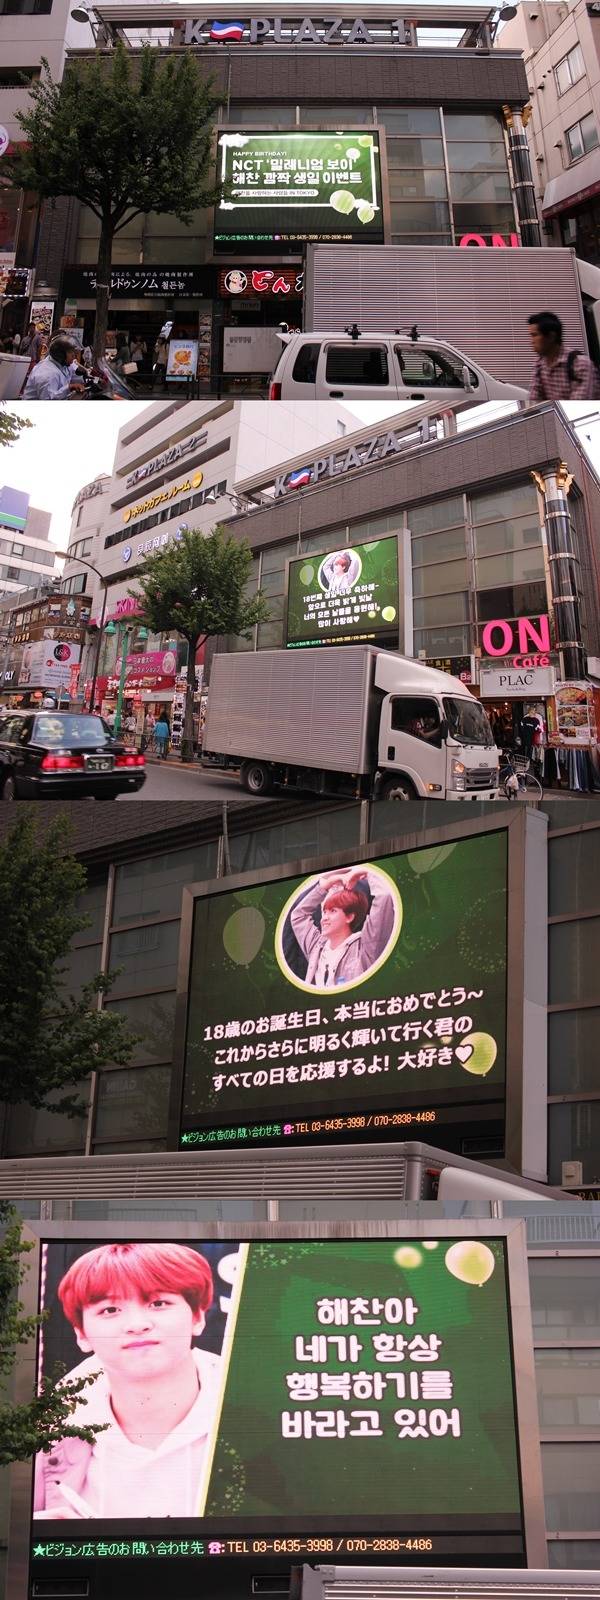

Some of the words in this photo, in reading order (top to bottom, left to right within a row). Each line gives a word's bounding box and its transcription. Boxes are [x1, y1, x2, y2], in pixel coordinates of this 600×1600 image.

[184, 19, 208, 44] K
[250, 18, 372, 44] PLAZA
[392, 18, 406, 44] 1
[232, 160, 263, 170] NCT
[327, 159, 357, 171] 보이'
[232, 172, 259, 184] 해찬
[263, 172, 291, 184] 깜짝
[294, 172, 319, 184] 생일
[322, 172, 362, 184] 이벤트
[274, 474, 288, 498] K
[311, 431, 401, 483] PLAZA
[482, 614, 550, 657] ON
[513, 652, 550, 669] Café
[499, 675, 533, 686] PLAC
[214, 1015, 473, 1066] これからさらに明るく輝いて行く君の
[397, 1047, 453, 1072] 大好き
[296, 1124, 310, 1134] TEL
[311, 1117, 366, 1132] 03-6435-3998
[374, 1111, 436, 1126] 070-2838-4486
[316, 1297, 418, 1327] 해찬아
[295, 1334, 362, 1364] 네가
[374, 1334, 442, 1363] 항상
[286, 1371, 454, 1401] 행복하기를
[281, 1409, 383, 1440] 바라고
[394, 1408, 461, 1439] 있어
[228, 1540, 249, 1553] TEL
[253, 1539, 334, 1553] 03-6435-3998
[346, 1538, 433, 1552] 070-2838-4486
